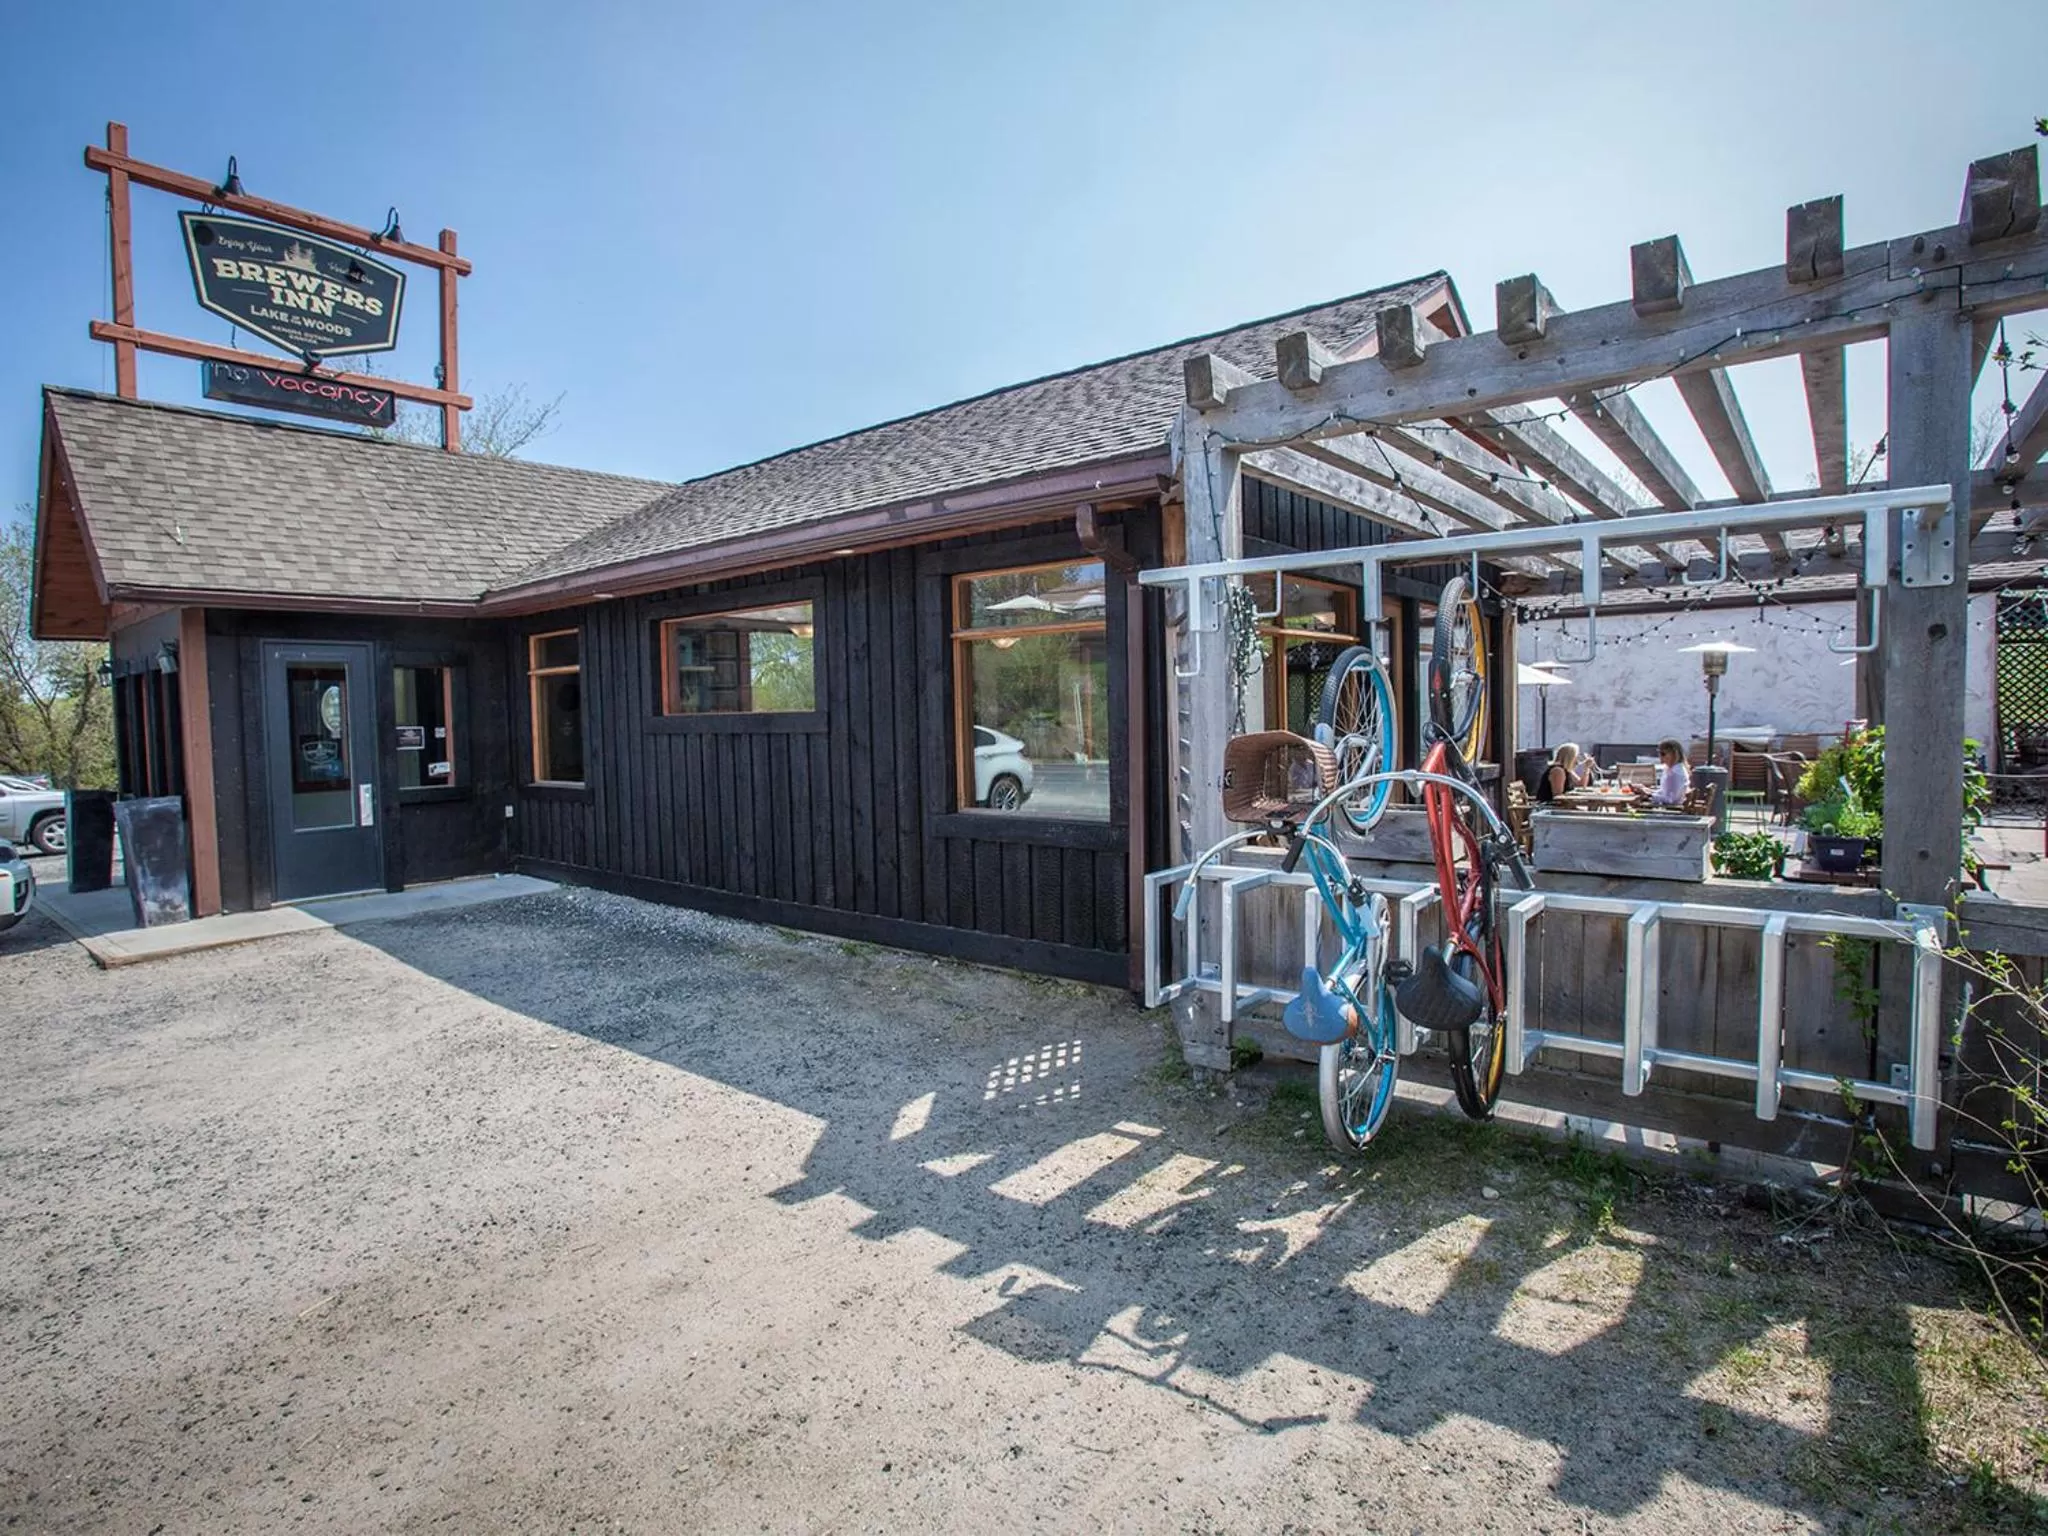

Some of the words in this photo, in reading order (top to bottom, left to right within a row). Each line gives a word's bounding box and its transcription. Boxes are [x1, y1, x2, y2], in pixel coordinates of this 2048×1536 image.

[211, 258, 383, 316] BREWERS
[270, 286, 335, 317] INN
[250, 304, 289, 323] LAKE
[302, 316, 353, 337] WOODS
[213, 361, 250, 381] no
[259, 369, 389, 417] vacancy
